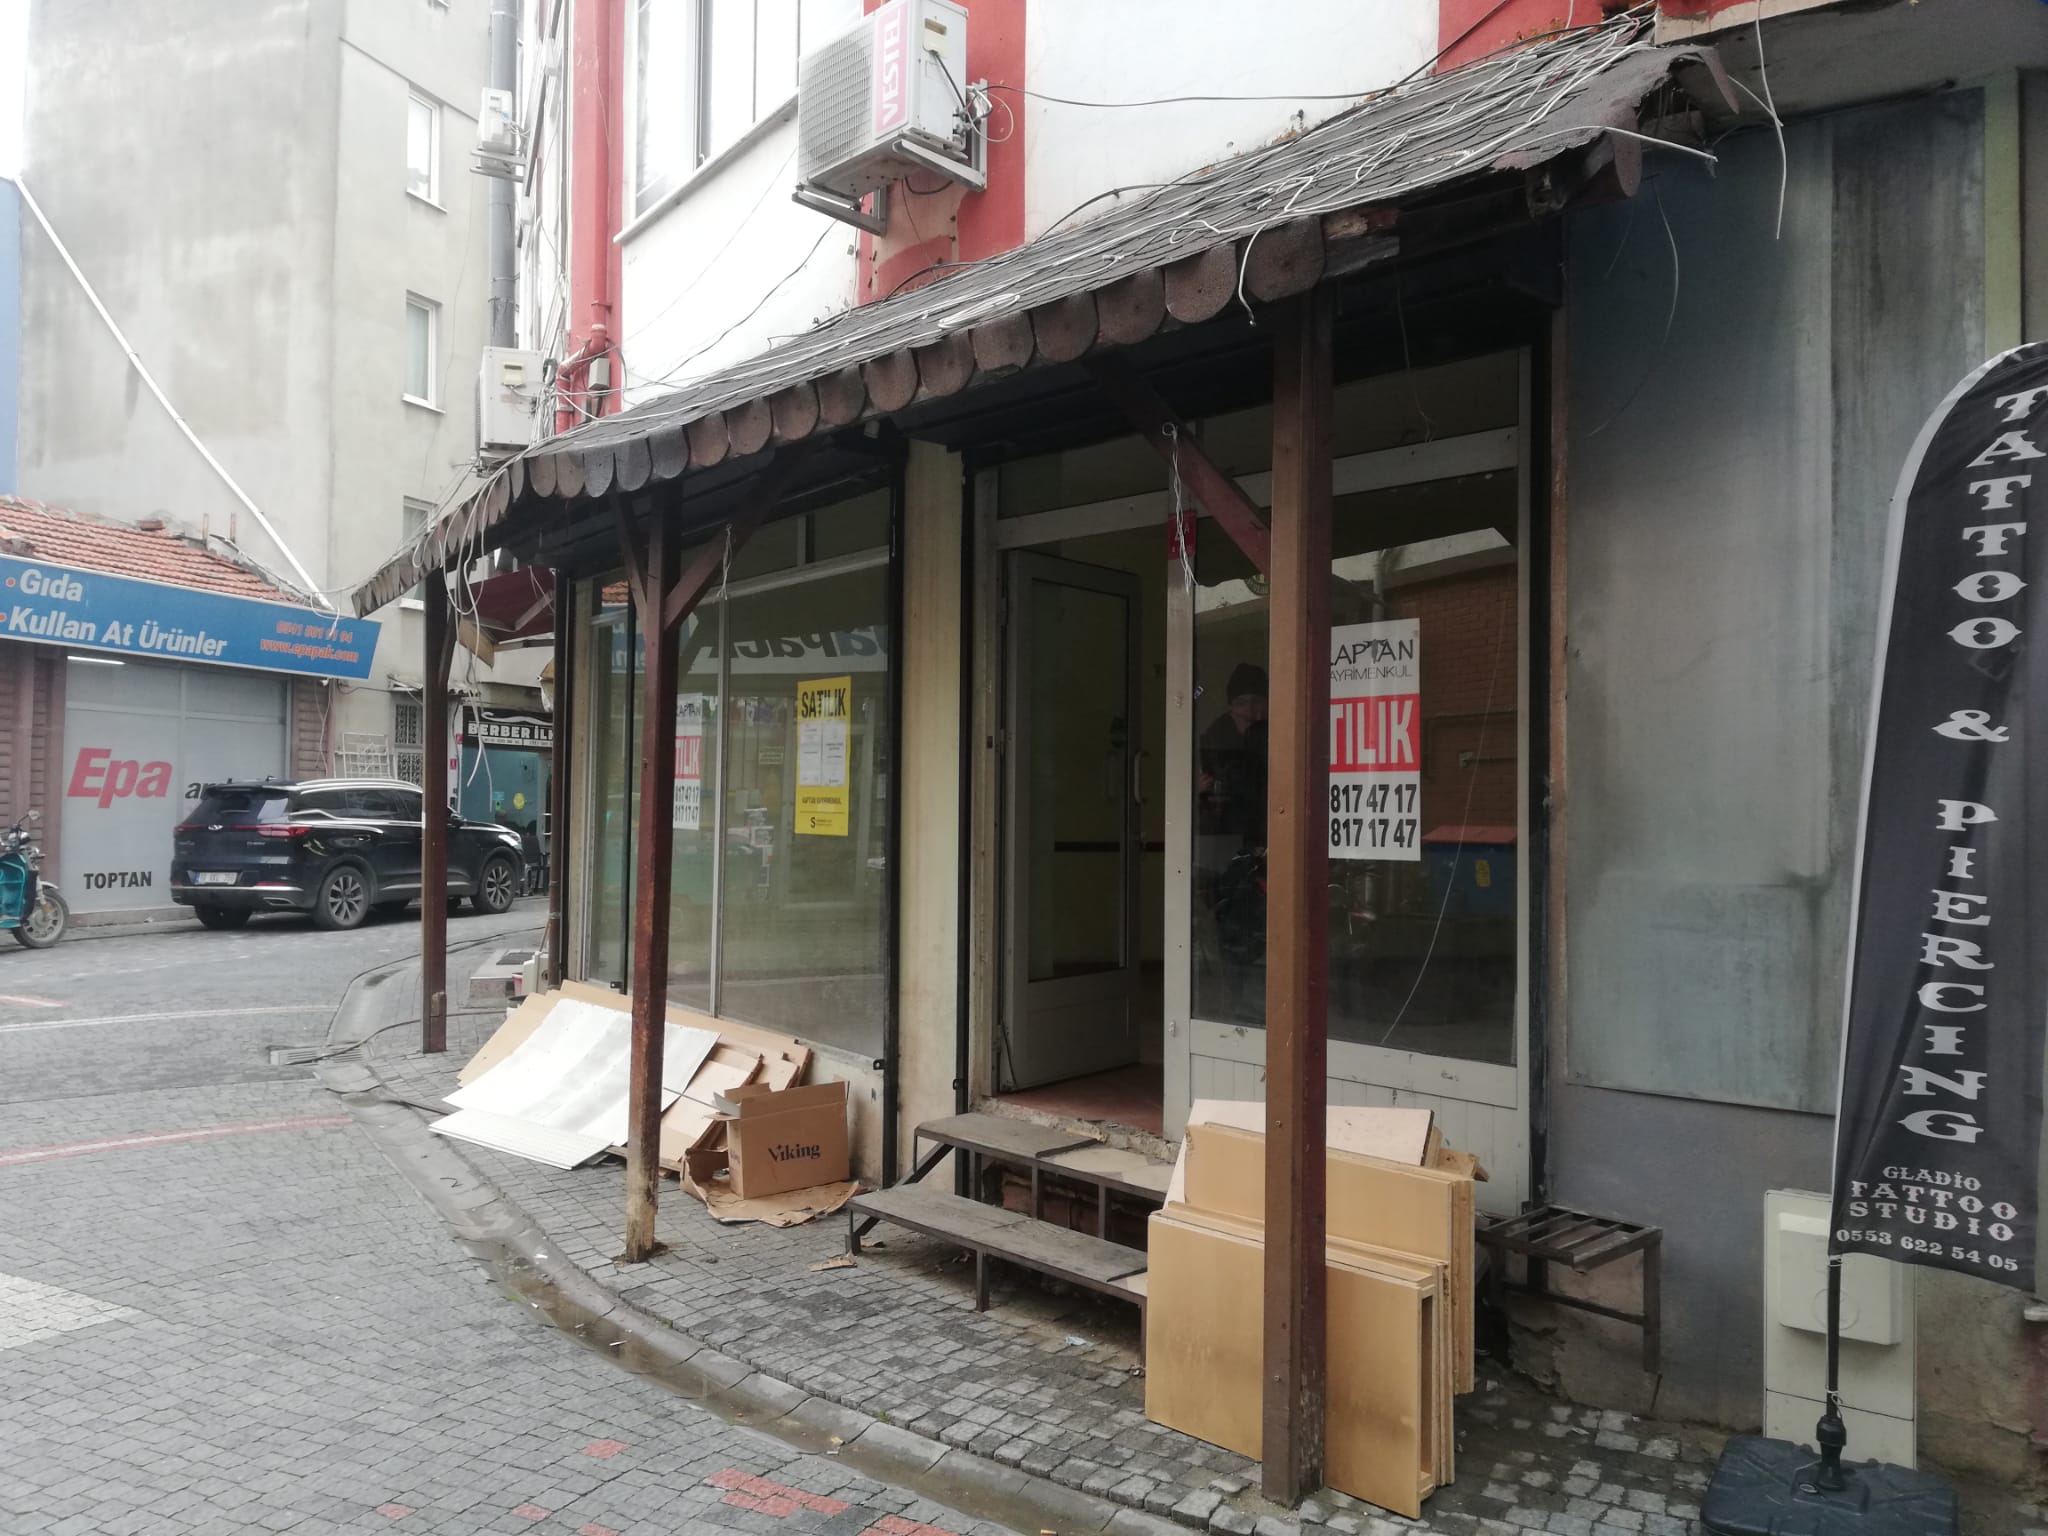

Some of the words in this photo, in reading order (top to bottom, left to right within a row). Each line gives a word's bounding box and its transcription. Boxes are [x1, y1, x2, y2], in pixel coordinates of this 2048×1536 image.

[882, 8, 900, 126] VESTEL
[1946, 385, 2048, 650] TATTOO
[19, 568, 83, 602] Gıda
[8, 606, 97, 642] Kullan
[101, 620, 134, 647] At
[138, 619, 228, 657] Ürünler
[1329, 638, 1413, 666] APTAN
[1329, 664, 1414, 683] AYRİMENKUL
[676, 703, 701, 718] APTAN
[801, 688, 846, 718] SATILIK
[468, 722, 531, 739] BERBER
[1328, 699, 1415, 766] TILIK
[1931, 709, 2010, 743] &
[674, 738, 701, 775] TILIK
[66, 747, 173, 809] Epa
[1330, 784, 1363, 813] 817
[1366, 784, 1390, 813] 47
[1394, 783, 1417, 813] 17
[1330, 818, 1363, 847] 817
[1368, 818, 1390, 847] 17
[1393, 818, 1417, 848] 47
[83, 871, 152, 890] TOPTAN
[1897, 799, 2000, 1144] PIERCING
[767, 1144, 821, 1162] Viking
[1850, 1201, 2016, 1242] STUDIO
[1836, 1229, 1893, 1246] 0553
[1900, 1236, 1944, 1256] 622
[1952, 1245, 1981, 1264] 54
[1988, 1253, 2019, 1272] 05
